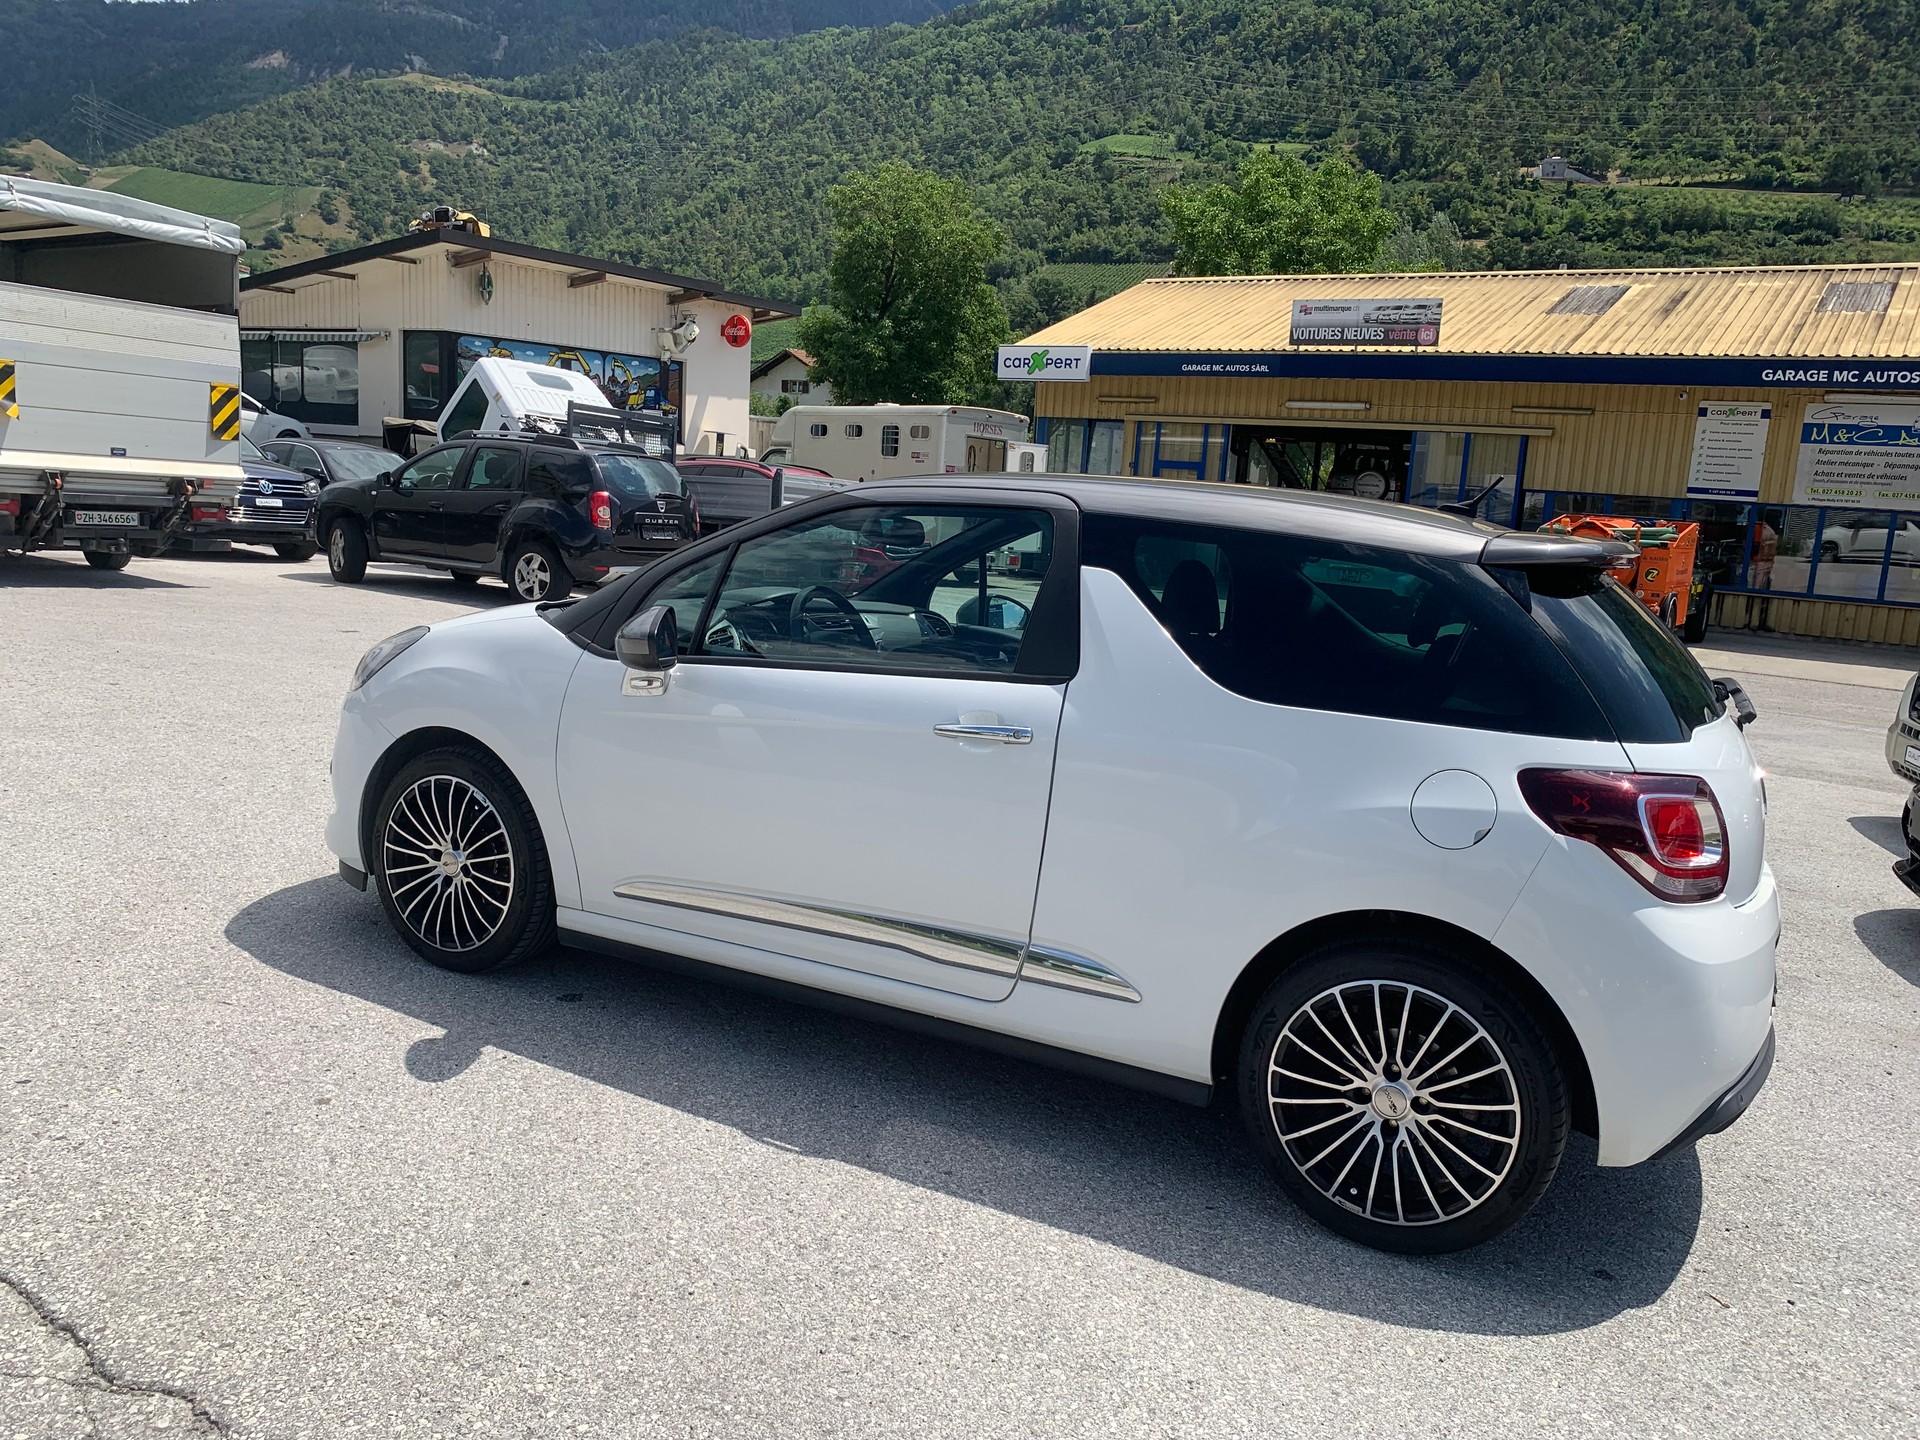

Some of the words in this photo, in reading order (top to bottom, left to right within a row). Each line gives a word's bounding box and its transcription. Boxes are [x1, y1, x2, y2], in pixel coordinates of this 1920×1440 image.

[1292, 327, 1341, 340] VOITURES
[1343, 327, 1384, 340] NEUVES
[1421, 328, 1434, 340] ici
[1181, 364, 1211, 372] GARAGE
[1212, 364, 1224, 372] MC
[1225, 364, 1250, 372] AUTOS
[1761, 369, 1828, 382] GARAGE
[1833, 370, 1859, 382] MC
[1863, 371, 1920, 383] AUTOS
[1811, 406, 1879, 427] Garage
[973, 422, 1003, 435] HORSES
[1810, 423, 1829, 443] M
[1834, 429, 1855, 442] &
[1853, 428, 1888, 443] C
[1818, 448, 1854, 458] Réparation
[1854, 449, 1863, 457] de
[1864, 449, 1893, 458] véhicules
[1894, 450, 1915, 458] toutes
[1838, 460, 1875, 469] mécanique
[1884, 462, 1920, 471] Dépannag
[1814, 470, 1835, 478] Achats
[1877, 473, 1907, 481] véhicules
